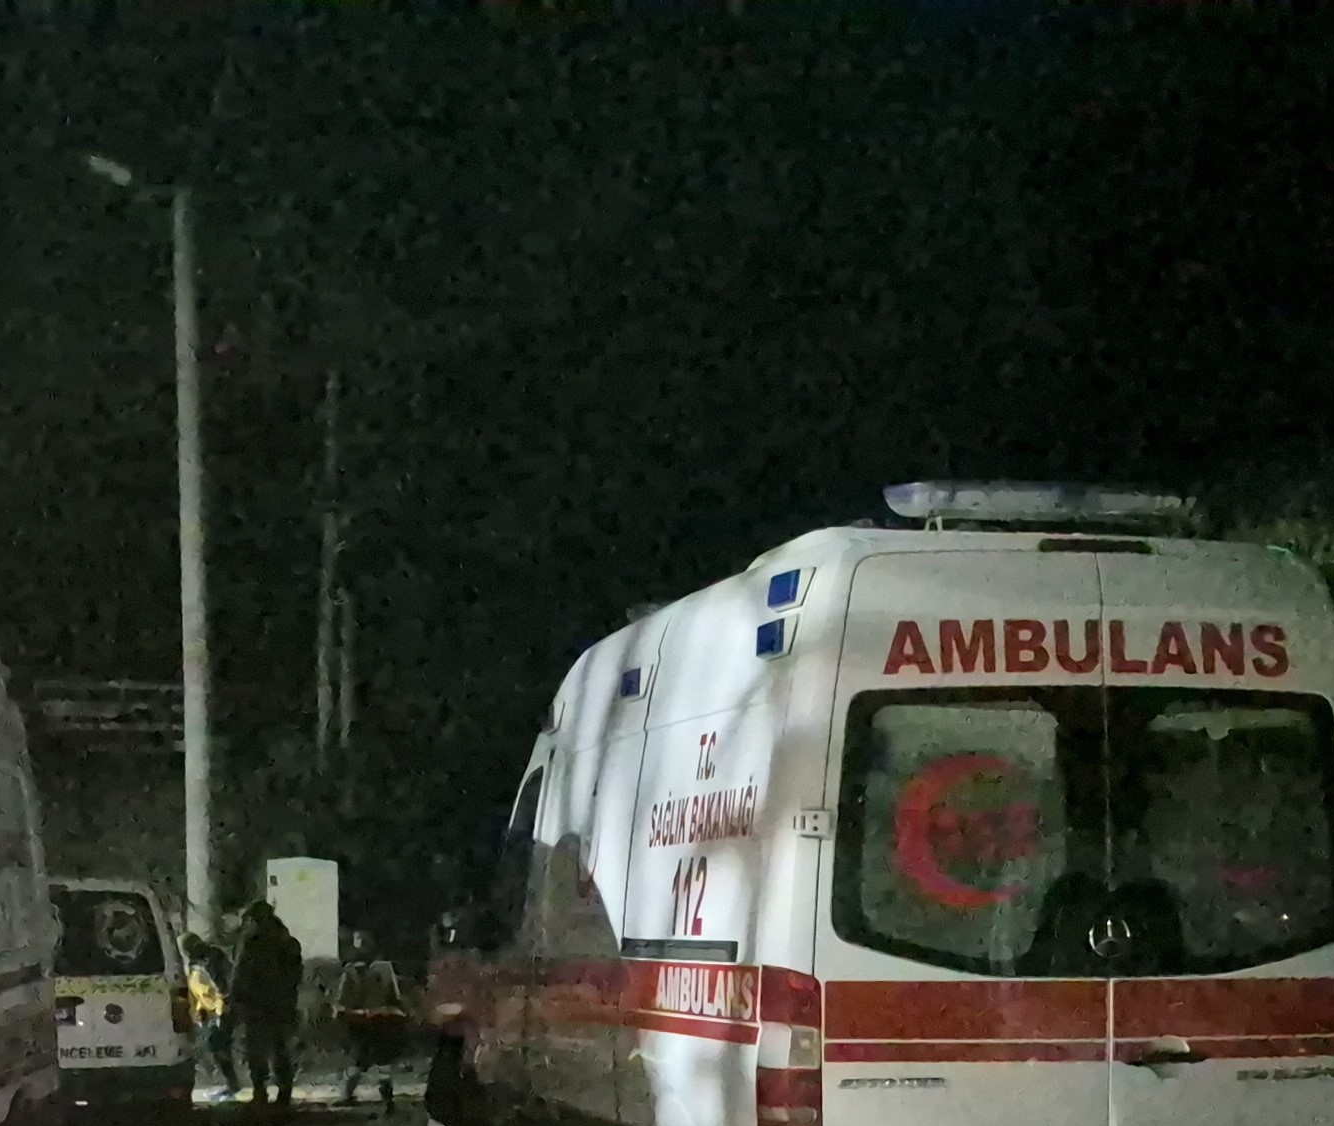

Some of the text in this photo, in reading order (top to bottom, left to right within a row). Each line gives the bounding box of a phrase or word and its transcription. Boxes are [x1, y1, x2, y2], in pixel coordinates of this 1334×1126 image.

[883, 619, 1289, 677] AMBULANS
[672, 856, 707, 936] 112
[656, 966, 754, 1020] AMBULANS
